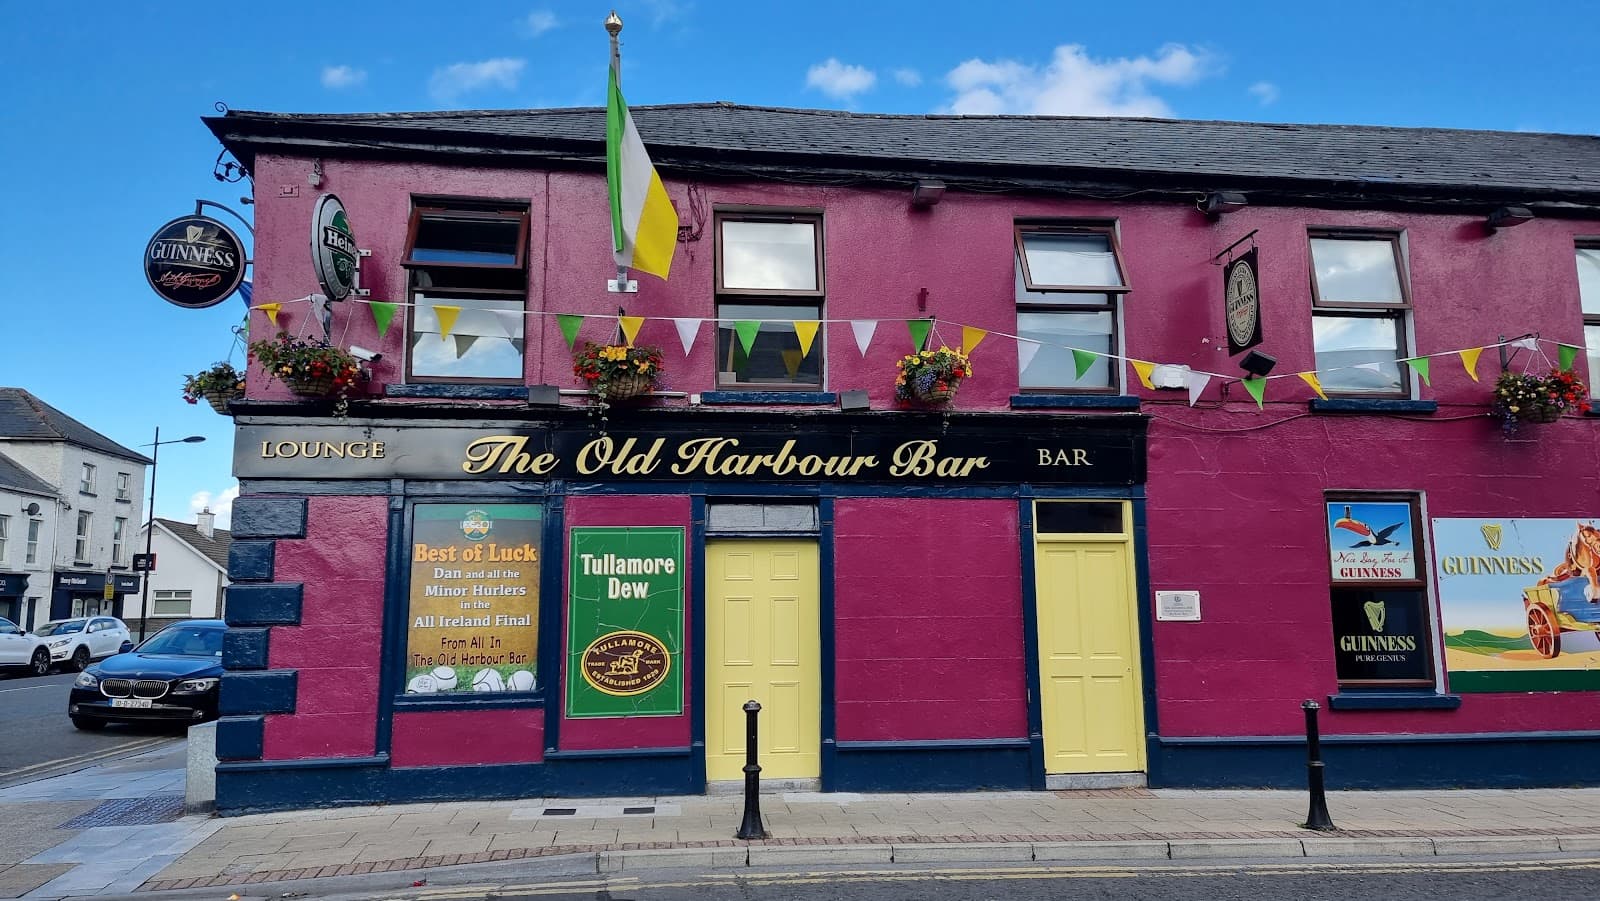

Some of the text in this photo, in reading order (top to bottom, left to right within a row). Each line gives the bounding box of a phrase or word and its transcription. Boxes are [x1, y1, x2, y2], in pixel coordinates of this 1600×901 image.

[150, 241, 235, 268] GUINNESS
[261, 441, 386, 459] LOUNGE
[462, 435, 990, 477] The Old Harbour Bar
[1037, 448, 1094, 466] BAR
[414, 543, 538, 562] Best of Luck
[1334, 551, 1356, 563] Nice
[1360, 551, 1378, 567] Day
[580, 553, 675, 575] Tullamore
[1340, 567, 1402, 578] GUINNESS
[1442, 555, 1545, 576] GUINNESS
[434, 567, 520, 579] Dan and all the
[424, 584, 527, 597] Minor Hurlers
[608, 577, 649, 599] Dew
[460, 600, 490, 609] in the
[413, 614, 531, 628] All Ireland Final
[441, 636, 501, 650] From All In
[592, 639, 658, 655] TULLAMORE
[1340, 635, 1417, 652] GUINNESS
[413, 651, 527, 666] The Old Harbour Bar
[591, 670, 641, 687] ESTABLISHED
